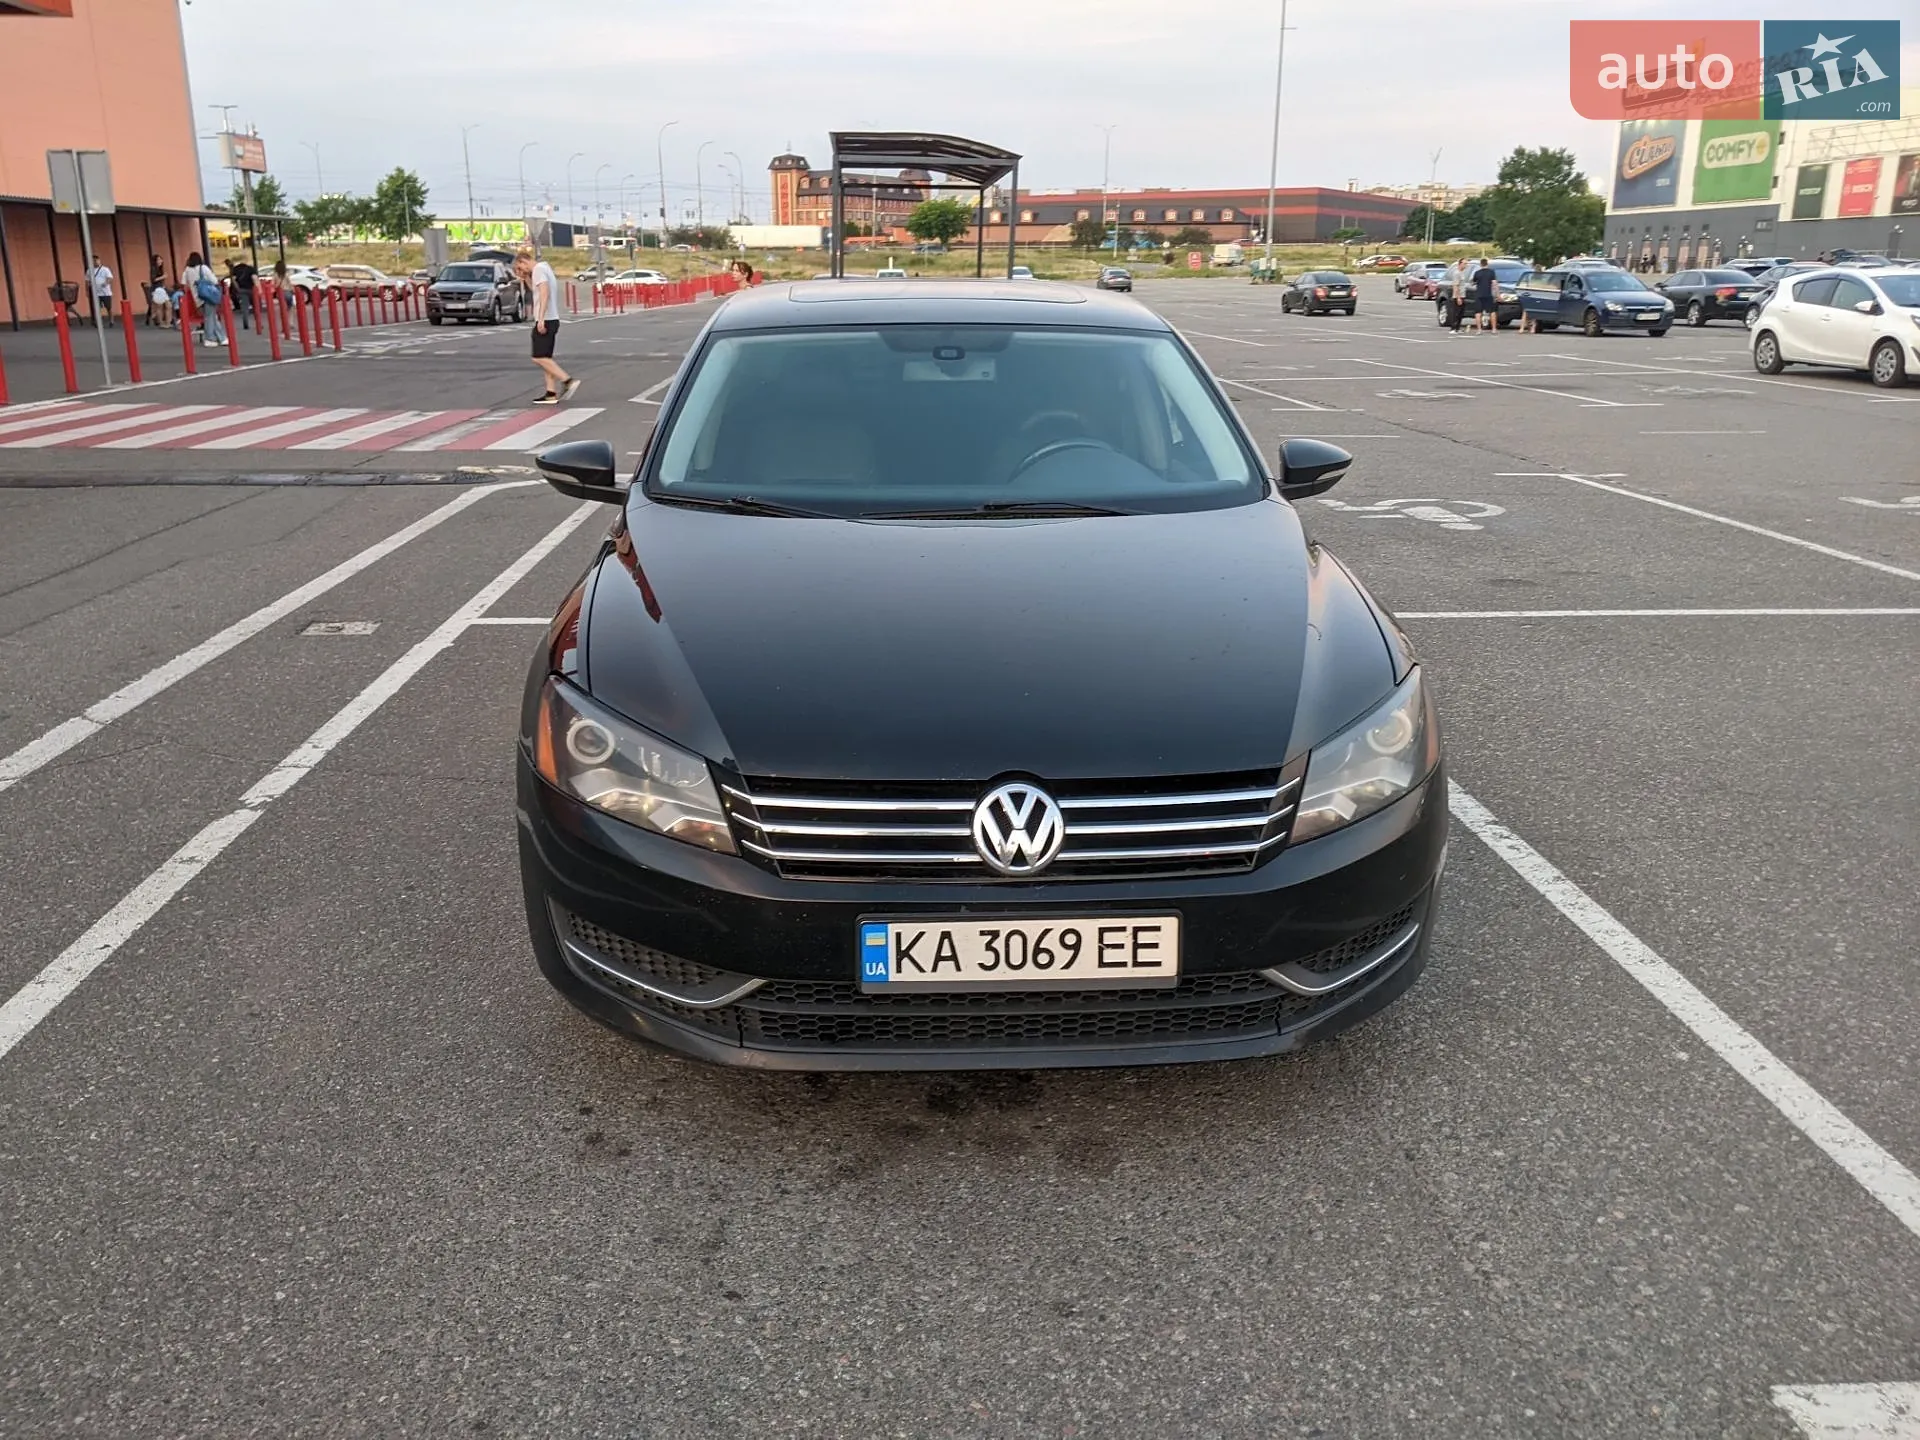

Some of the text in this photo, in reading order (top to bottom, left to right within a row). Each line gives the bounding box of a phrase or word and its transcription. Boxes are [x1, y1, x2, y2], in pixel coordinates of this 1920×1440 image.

[1706, 139, 1756, 163] COMFY
[446, 222, 525, 241] NOVUS
[895, 925, 1162, 974] KA 3069 EE
[865, 962, 886, 976] UA
